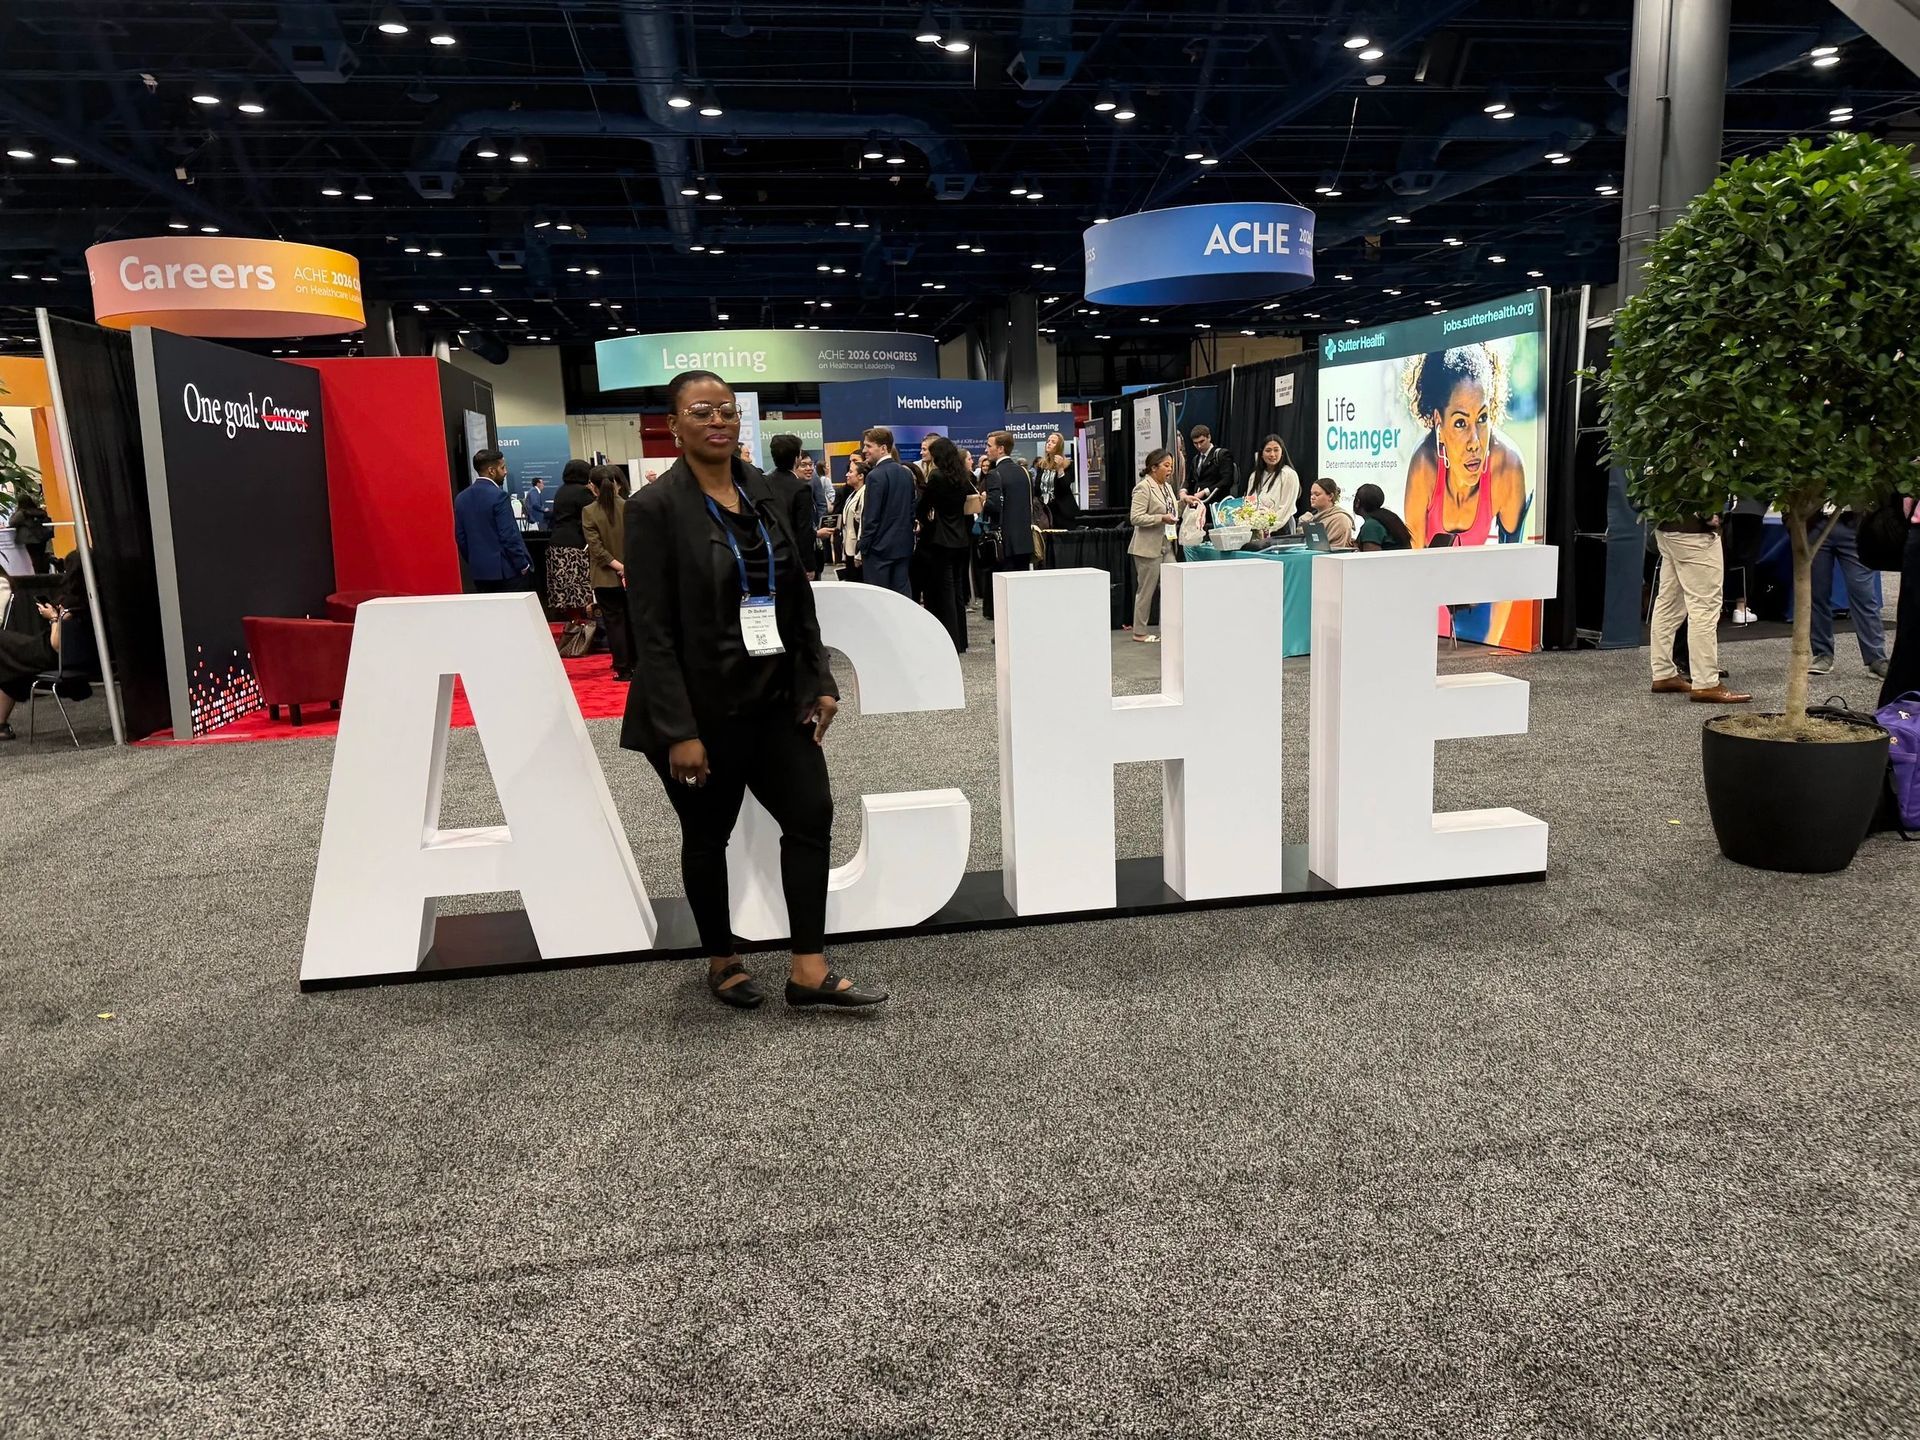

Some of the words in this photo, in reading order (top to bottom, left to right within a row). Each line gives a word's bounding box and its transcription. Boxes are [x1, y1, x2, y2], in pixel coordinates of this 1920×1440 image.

[1203, 222, 1290, 256] ACHE
[119, 256, 276, 291] Careers
[293, 267, 329, 284] ACHE
[331, 272, 352, 288] 2026
[295, 285, 308, 295] on
[1443, 302, 1534, 335] jobs.sutterhealth.org
[1338, 338, 1360, 353] Sutter
[1360, 333, 1385, 350] Health
[662, 346, 767, 373] Learning
[817, 350, 845, 360] ACHE
[847, 350, 870, 360] 2026
[872, 351, 918, 362] CONGRESS
[830, 362, 863, 370] Healthcare
[864, 362, 896, 371] Leadership
[183, 382, 222, 423] One
[224, 392, 259, 439] goal:
[897, 395, 963, 413] Membership
[1327, 397, 1356, 422] Life
[1027, 422, 1059, 432] Learning
[1326, 425, 1401, 456] Changer
[1325, 460, 1364, 469] Determination
[1364, 461, 1380, 469] never
[1380, 460, 1398, 469] stops
[300, 543, 1559, 984] ACHE
